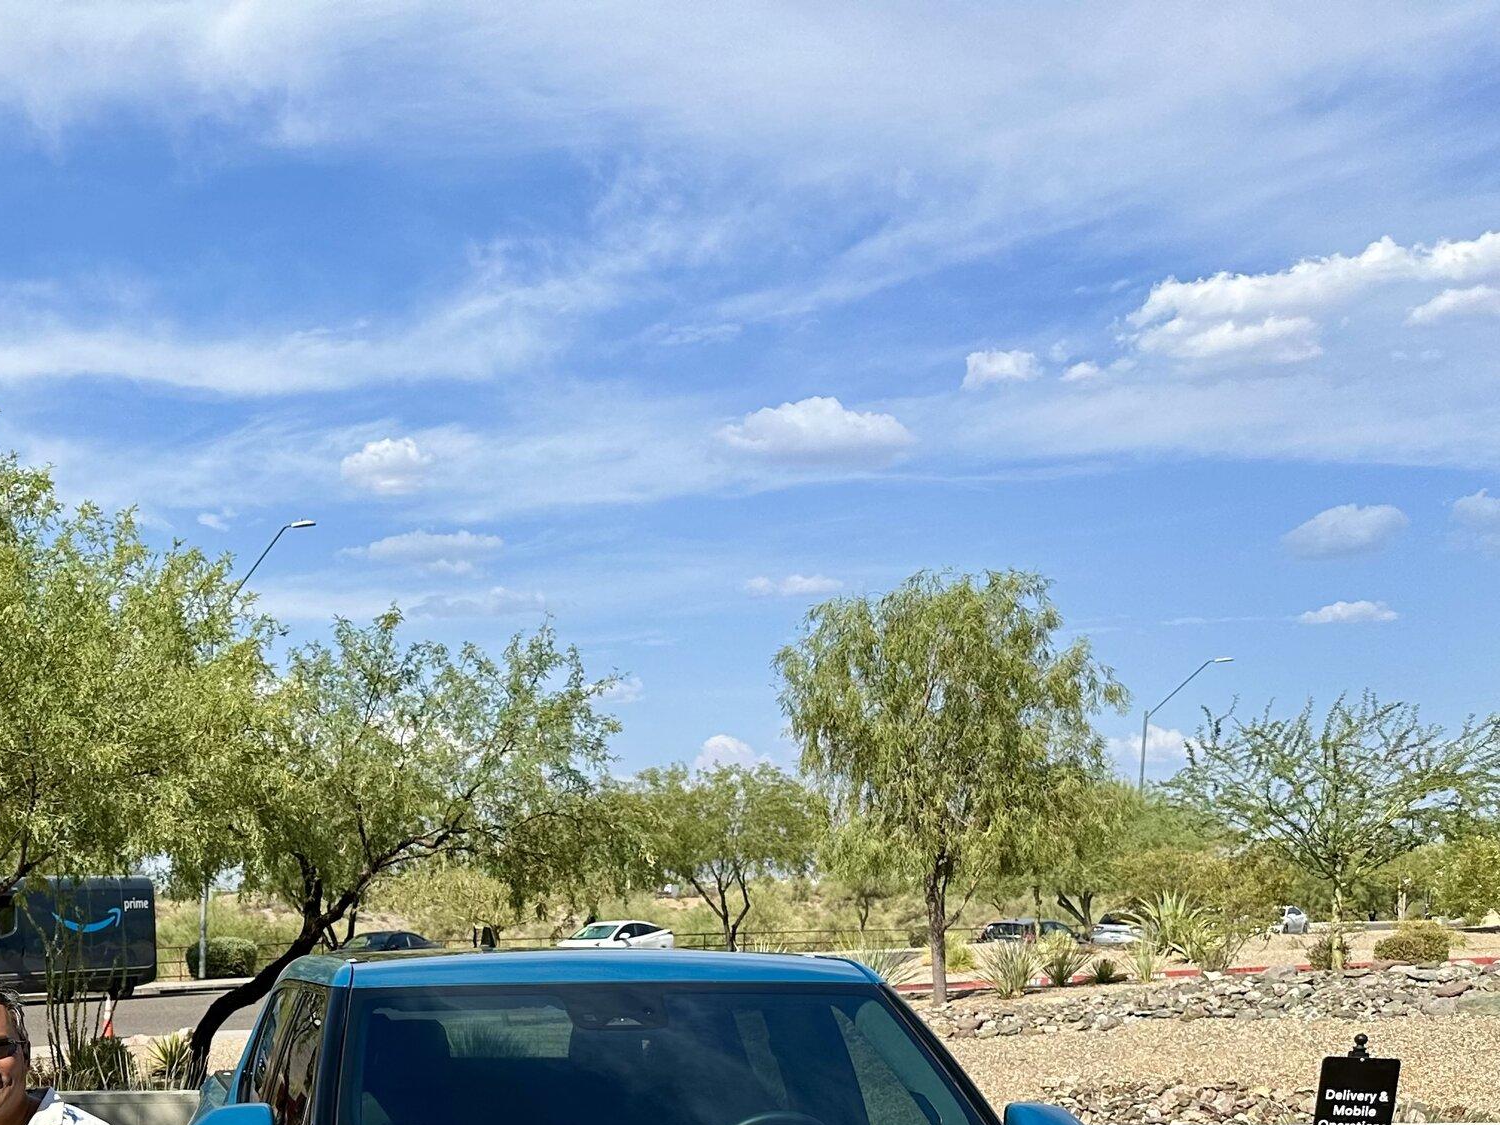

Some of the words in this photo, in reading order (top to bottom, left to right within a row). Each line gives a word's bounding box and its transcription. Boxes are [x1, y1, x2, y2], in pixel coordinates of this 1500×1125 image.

[123, 897, 149, 912] prime
[1325, 1089, 1377, 1104] Delivery
[1379, 1091, 1389, 1102] &
[1332, 1104, 1377, 1117] Mobile
